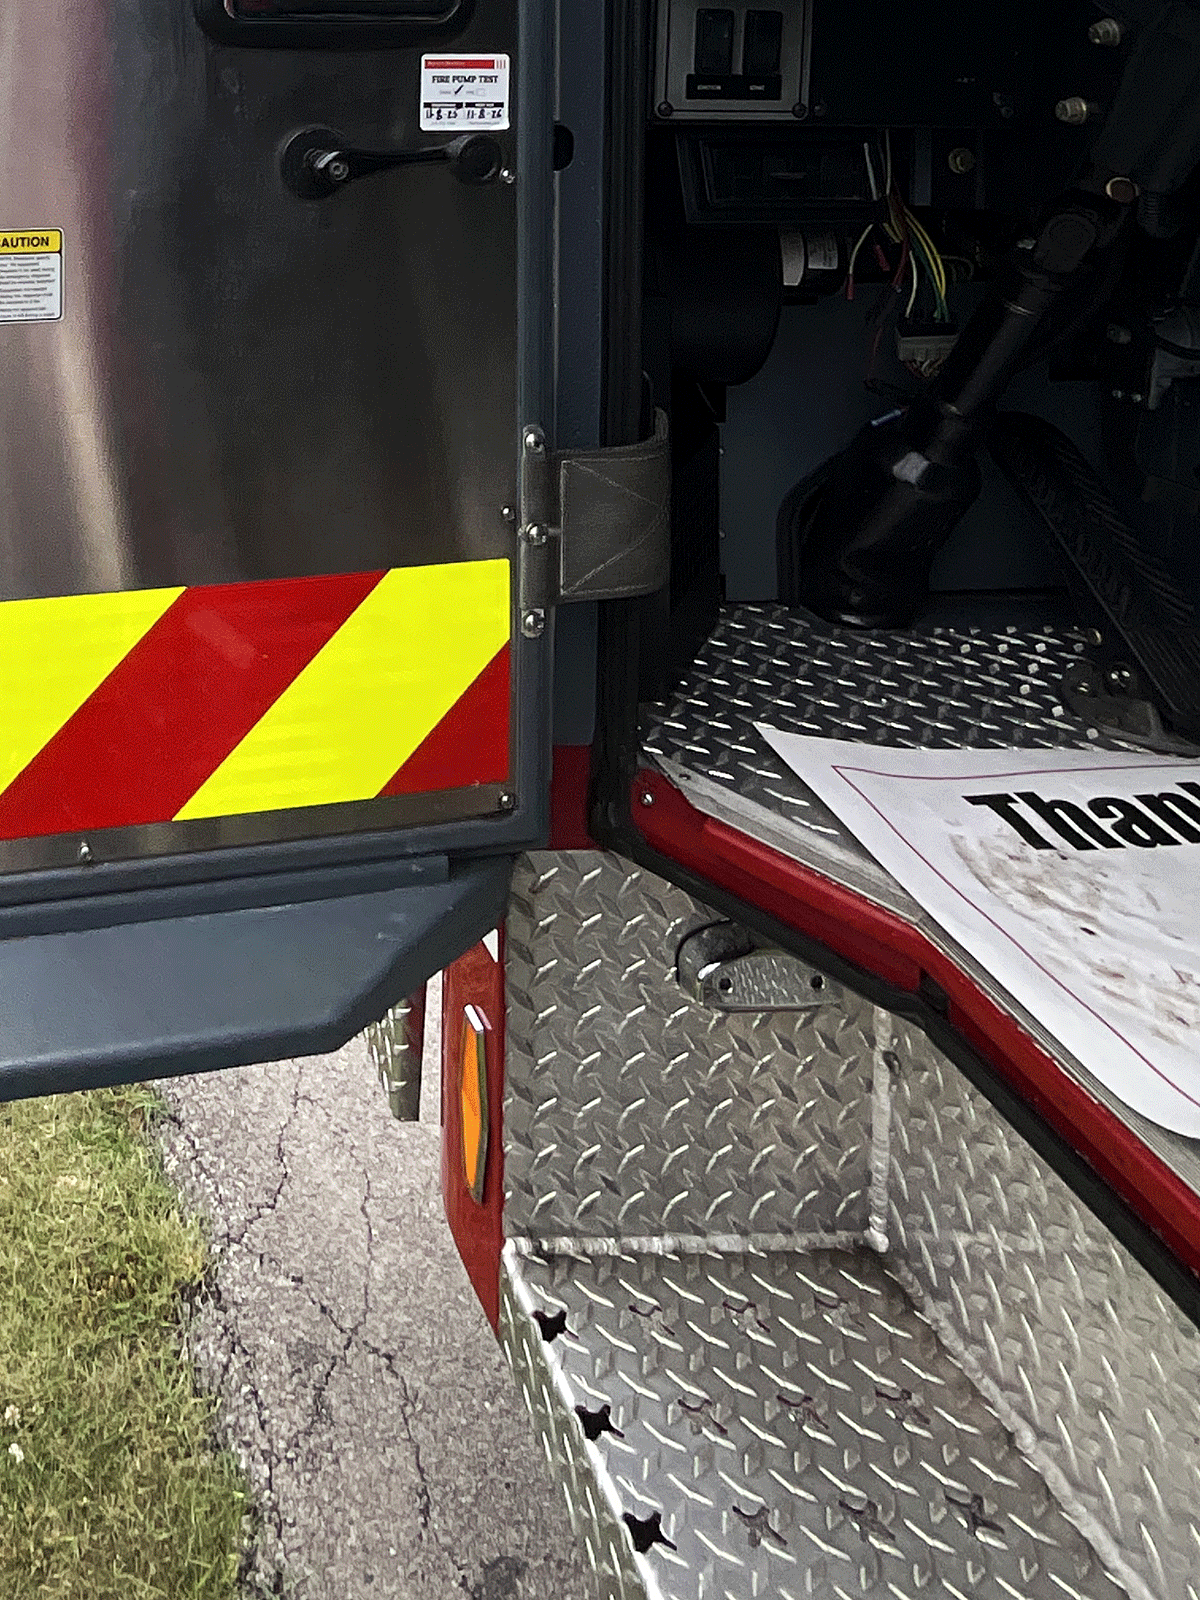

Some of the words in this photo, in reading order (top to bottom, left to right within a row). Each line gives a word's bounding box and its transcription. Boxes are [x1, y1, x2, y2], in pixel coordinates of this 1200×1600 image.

[432, 75, 450, 83] FIRE
[452, 75, 477, 83] PUMP
[479, 75, 498, 83] TEST
[961, 781, 1200, 850] Than
